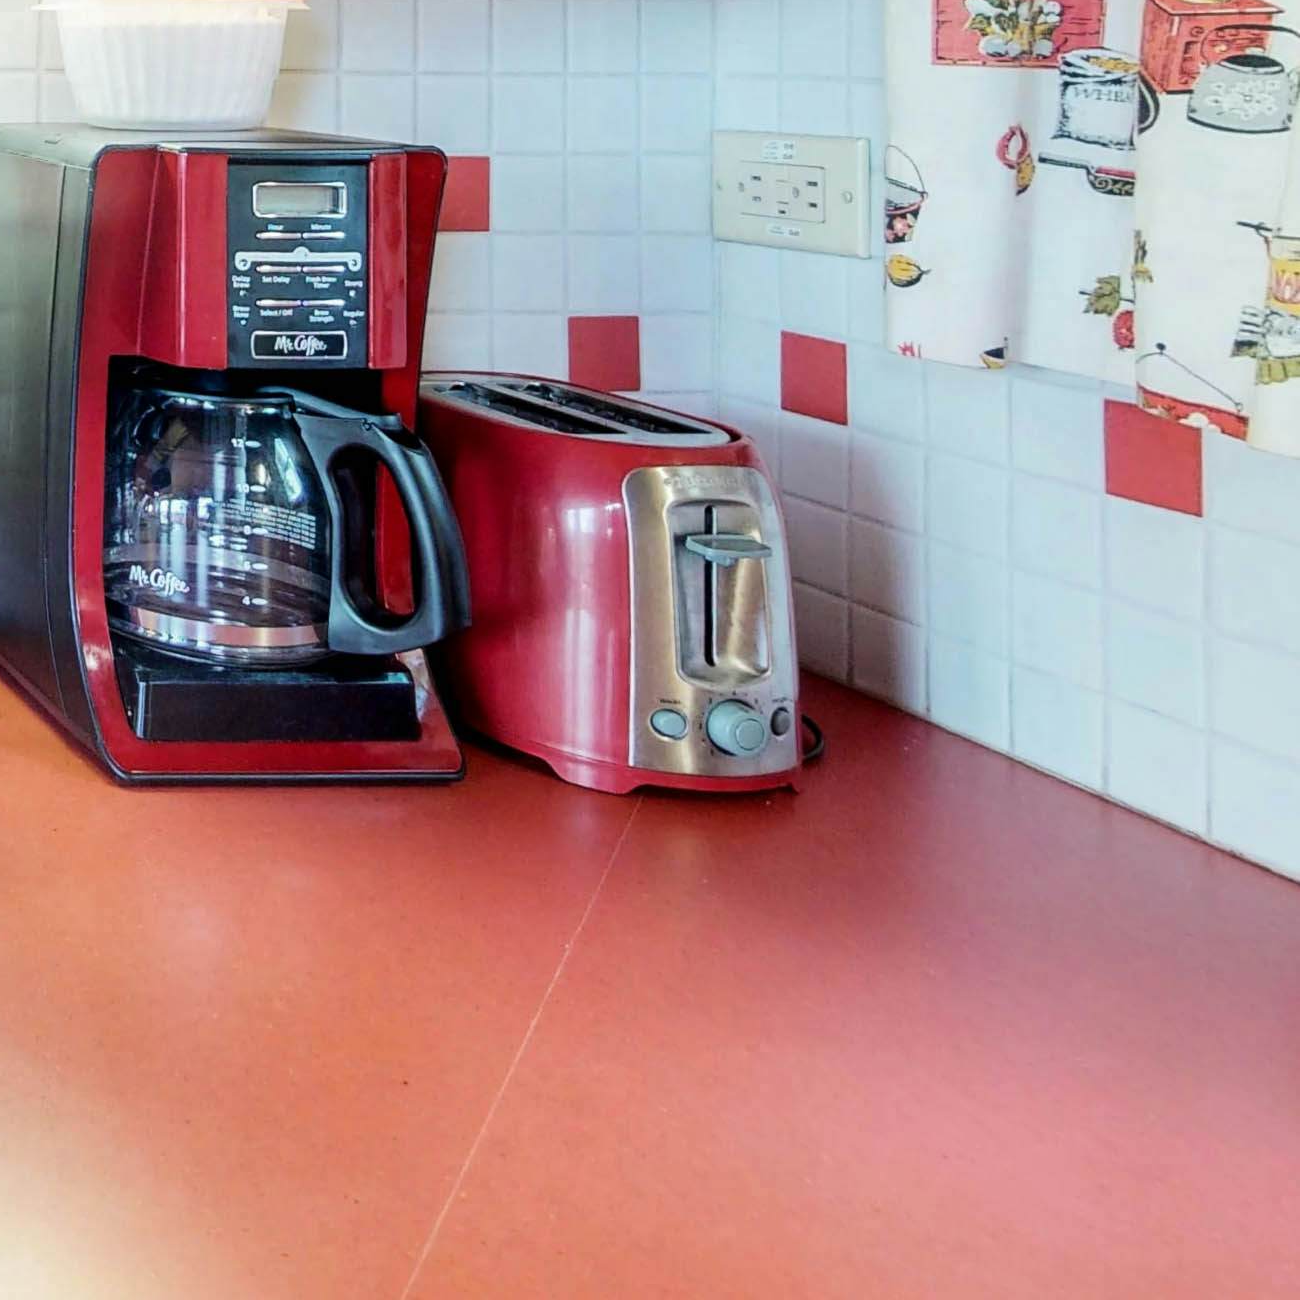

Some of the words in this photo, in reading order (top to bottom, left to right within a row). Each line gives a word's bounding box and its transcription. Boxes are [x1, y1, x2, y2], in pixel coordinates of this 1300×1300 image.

[273, 276, 291, 284] Delay
[294, 335, 327, 356] Coffee
[231, 438, 243, 447] 12
[150, 568, 190, 595] Coffee
[242, 597, 250, 605] 4
